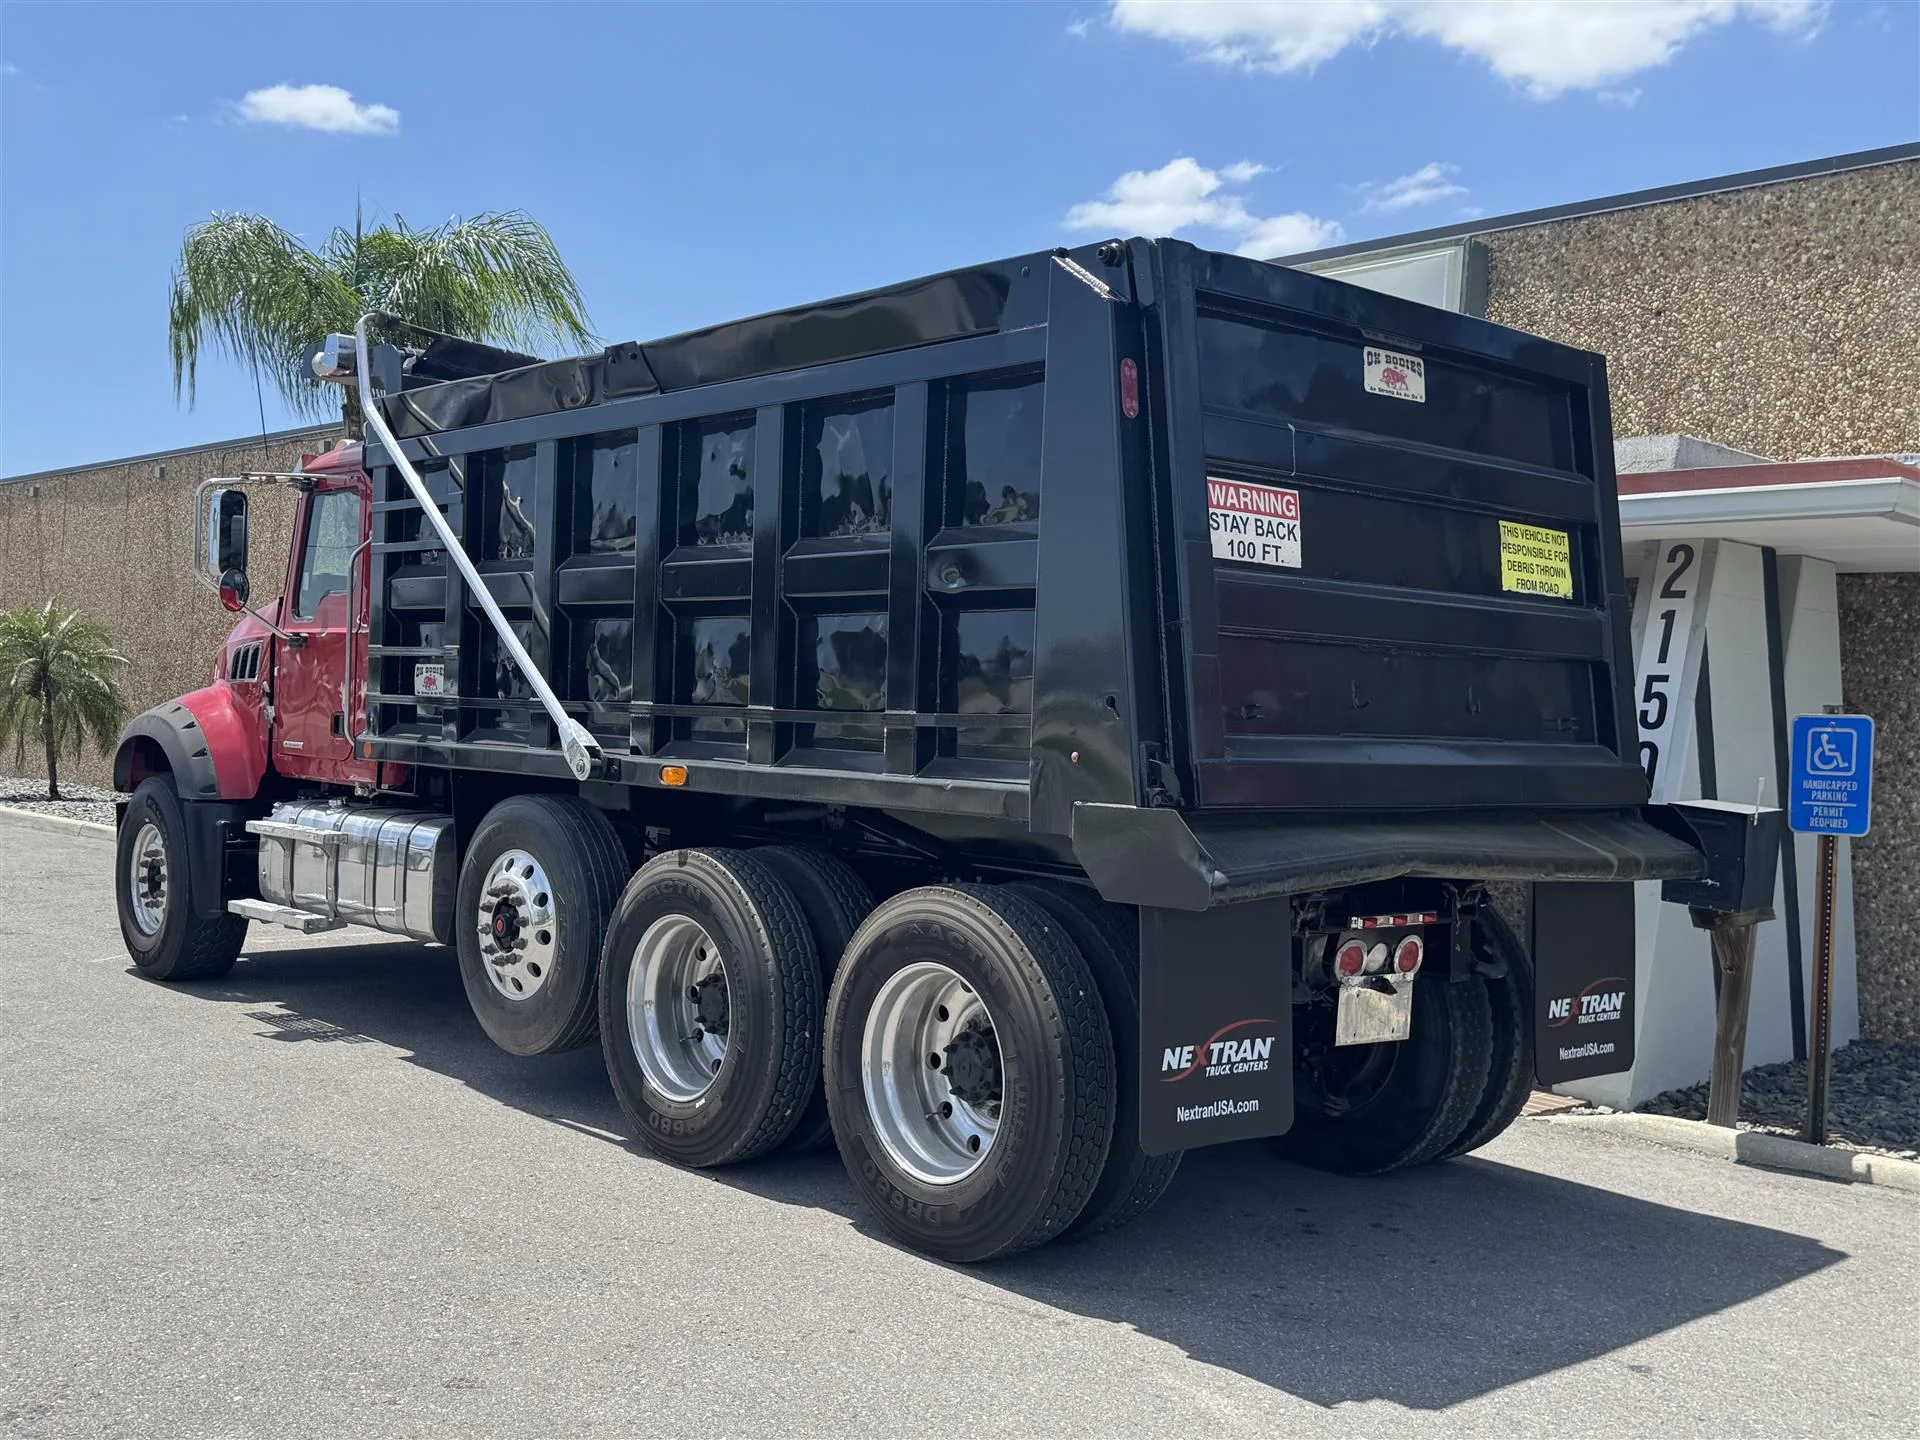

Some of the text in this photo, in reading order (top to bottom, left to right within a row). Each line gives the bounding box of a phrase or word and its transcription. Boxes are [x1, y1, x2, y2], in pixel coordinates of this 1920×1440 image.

[1385, 354, 1422, 378] BODIES
[1208, 483, 1296, 517] WARNING
[1209, 512, 1298, 542] STAY BACK
[1502, 525, 1566, 546] THIS VEHICLE NOT
[1227, 539, 1284, 563] 100 FT.
[1502, 542, 1569, 563] RESPONSIBLE FOR
[1507, 560, 1566, 579] DEBRIS THROWN
[1516, 578, 1560, 595] FROM ROAD
[1802, 779, 1858, 791] HANDICAPPED
[1811, 790, 1848, 802] PARKING
[1812, 806, 1844, 817] PERMIT
[1547, 991, 1625, 1019] NEXTRAN
[1578, 1010, 1621, 1024] TRUCK CENTERS
[1161, 1037, 1275, 1071] NEXTRAN
[1559, 1042, 1615, 1061] NextranUSA.com
[1205, 1060, 1269, 1077] TRUCK CENTERS
[1176, 1099, 1259, 1122] NextranUSA.com
